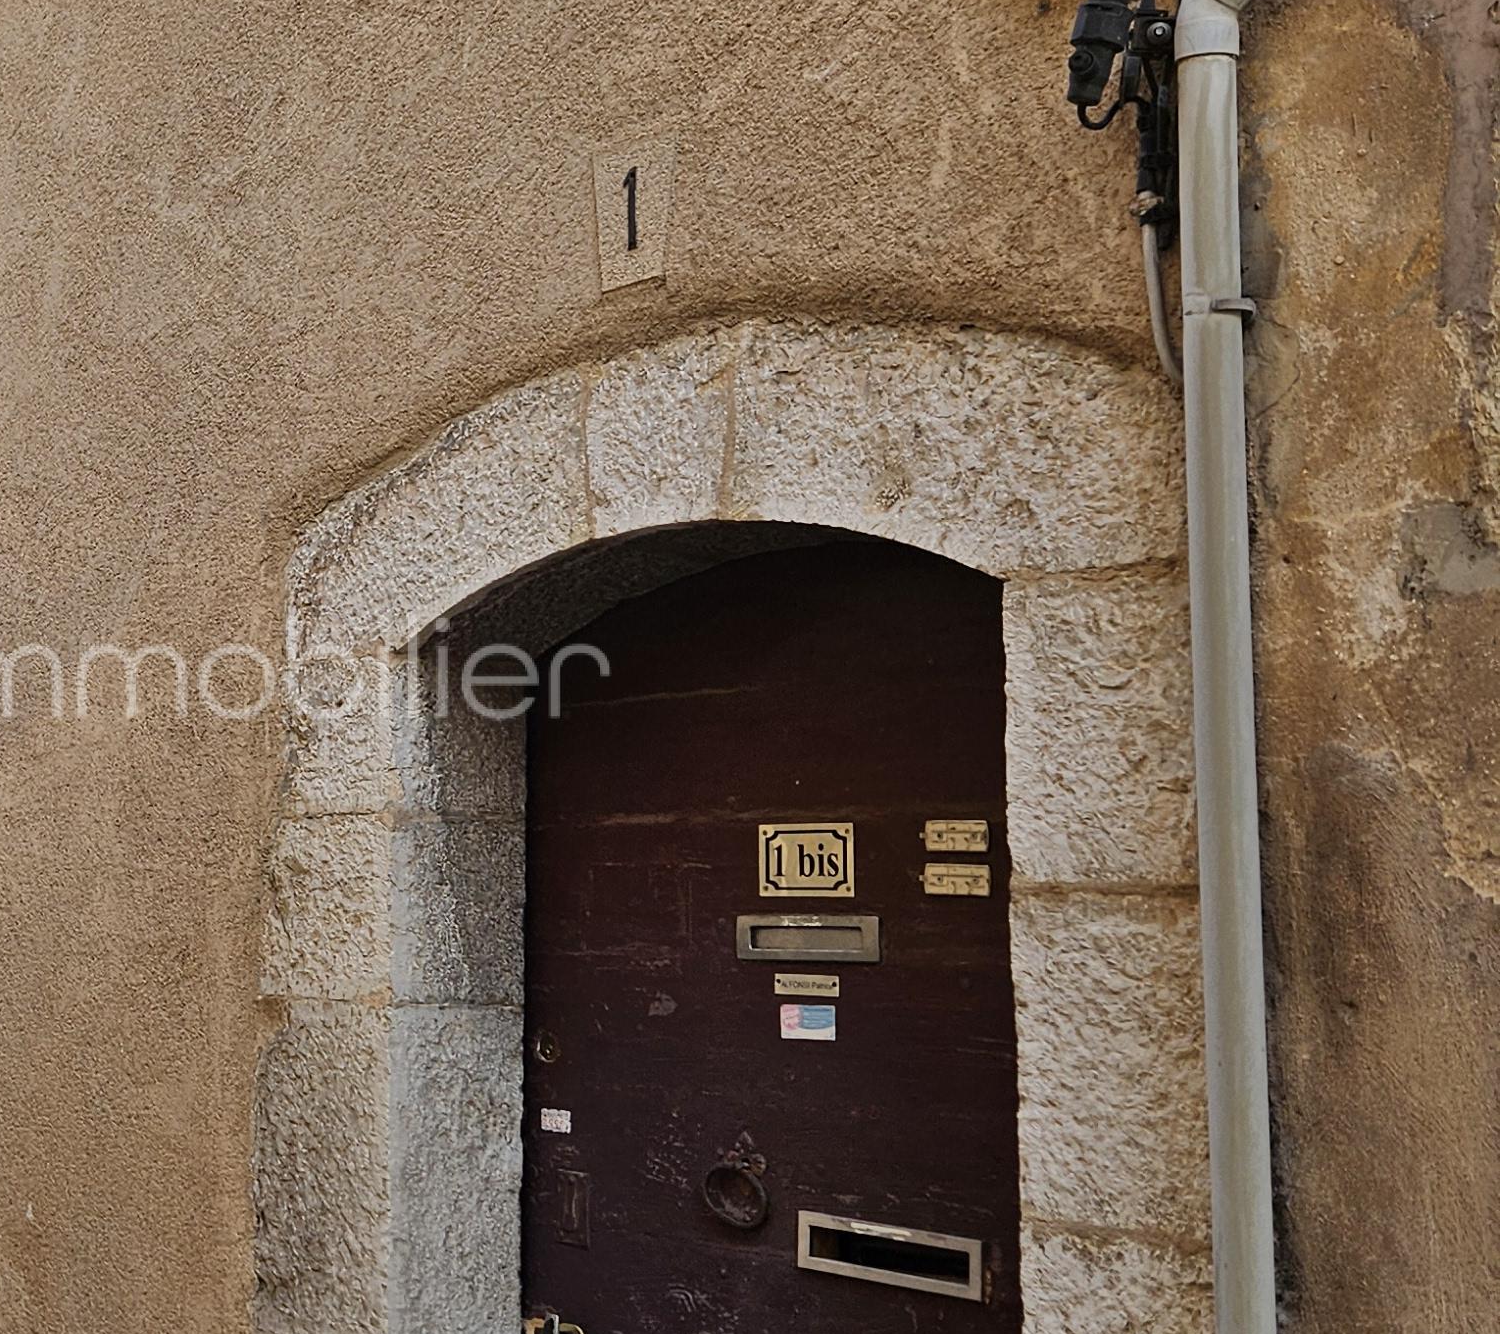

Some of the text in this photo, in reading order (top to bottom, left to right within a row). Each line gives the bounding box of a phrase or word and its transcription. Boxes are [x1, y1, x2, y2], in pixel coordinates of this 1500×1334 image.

[623, 166, 637, 251] 1
[773, 842, 840, 878] 1 bis
